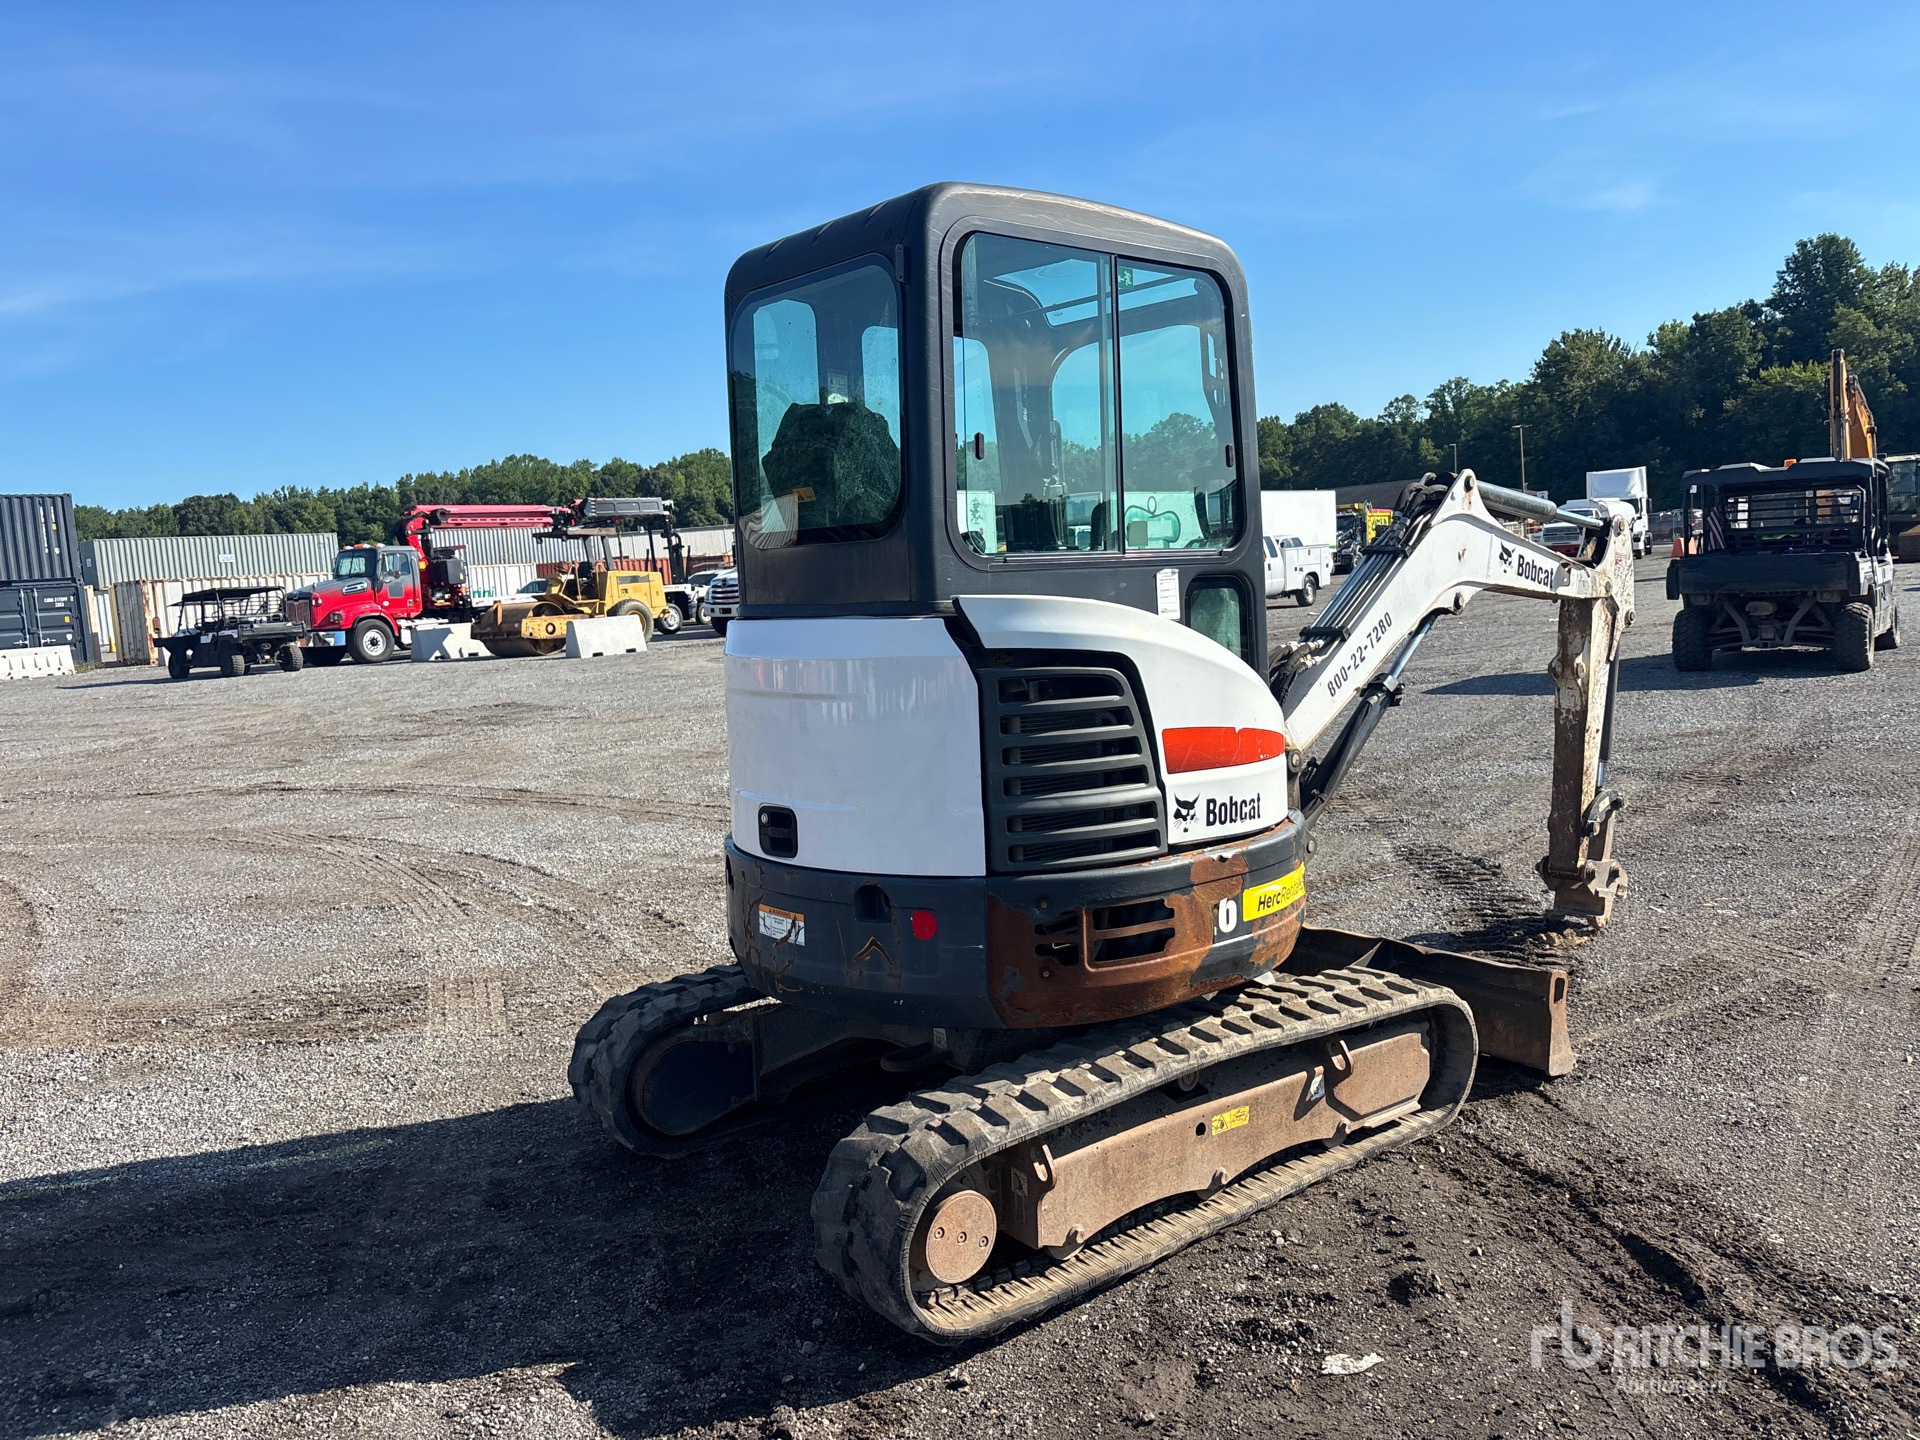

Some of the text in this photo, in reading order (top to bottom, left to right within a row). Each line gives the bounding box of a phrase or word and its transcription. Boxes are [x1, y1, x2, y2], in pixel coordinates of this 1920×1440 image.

[1517, 554, 1553, 589] Bobcat
[1327, 612, 1392, 697] 800-22-7280
[1206, 793, 1261, 827] Bobcat
